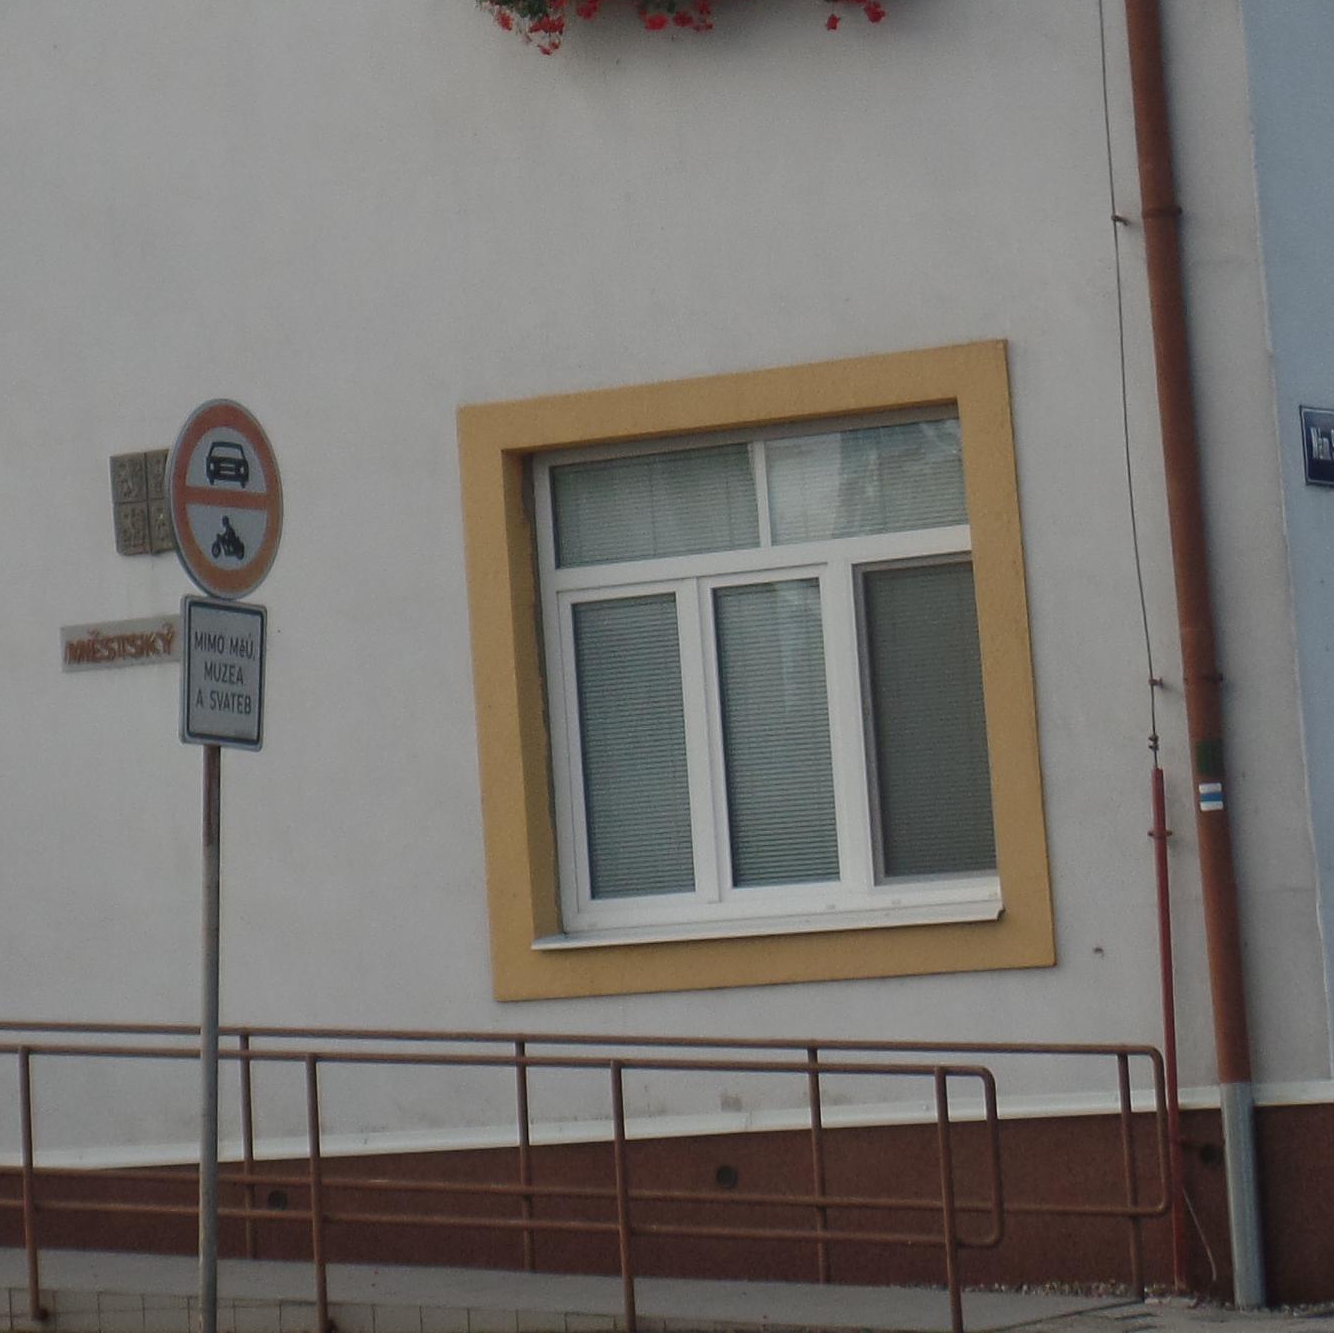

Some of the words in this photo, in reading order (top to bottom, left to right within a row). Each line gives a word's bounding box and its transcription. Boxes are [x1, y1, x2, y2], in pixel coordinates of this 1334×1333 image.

[65, 621, 176, 665] MĚSTSKÝ
[194, 630, 225, 655] MIMO
[203, 661, 244, 686] MUZEA
[195, 686, 204, 708] A
[209, 689, 252, 715] SVATEB
